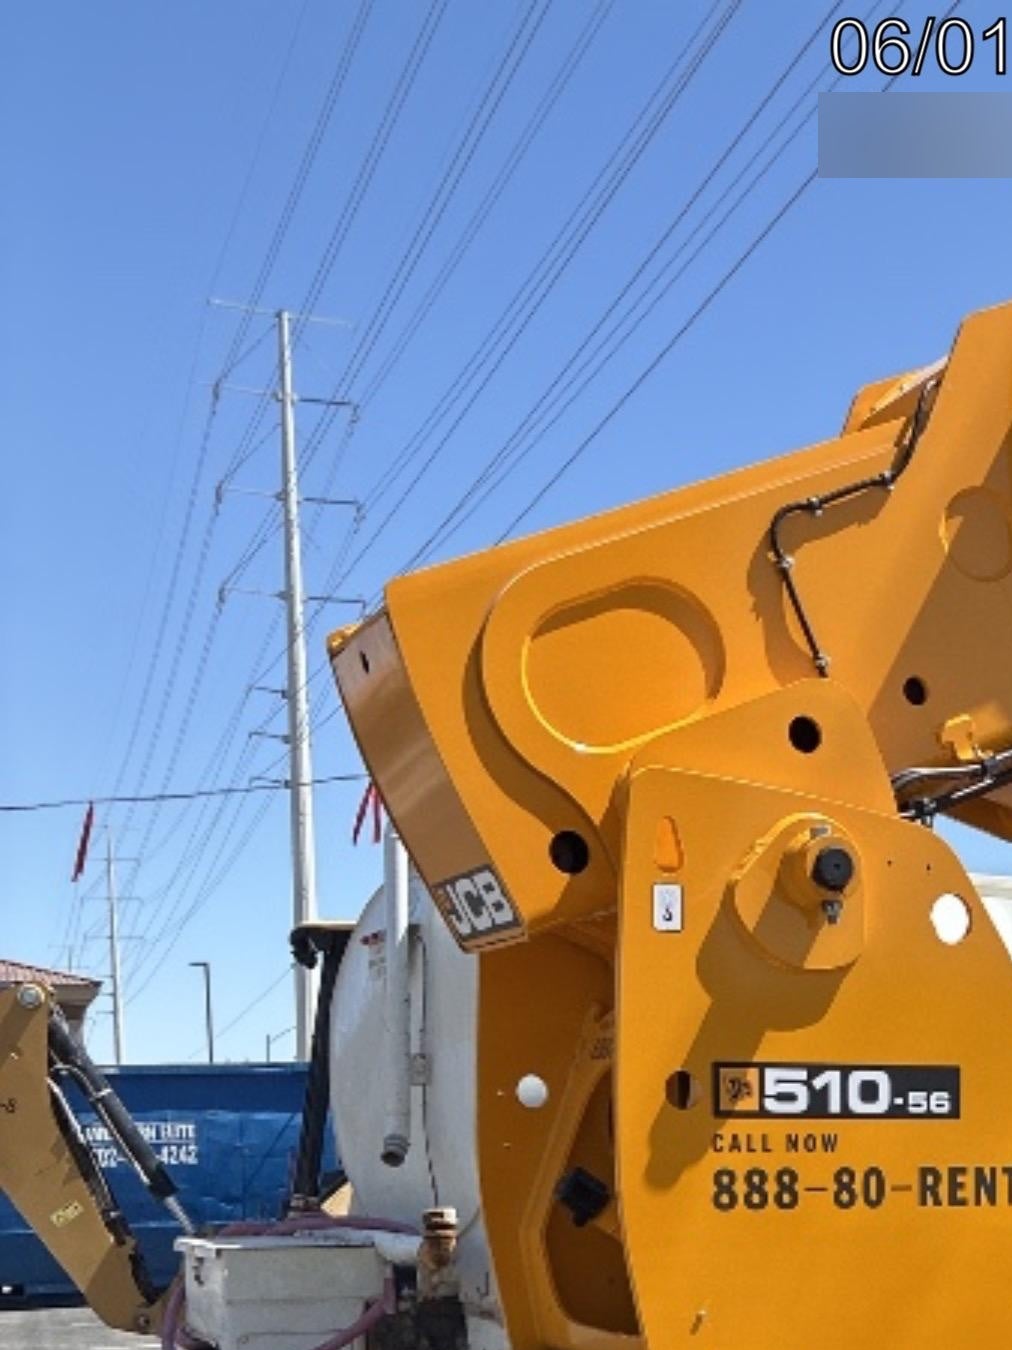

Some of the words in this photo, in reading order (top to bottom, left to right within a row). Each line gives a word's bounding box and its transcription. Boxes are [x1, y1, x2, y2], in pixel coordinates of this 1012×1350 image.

[446, 869, 515, 935] JCB
[763, 1067, 952, 1115] 510-56
[712, 1133, 773, 1153] CALL
[785, 1133, 839, 1153] NOW
